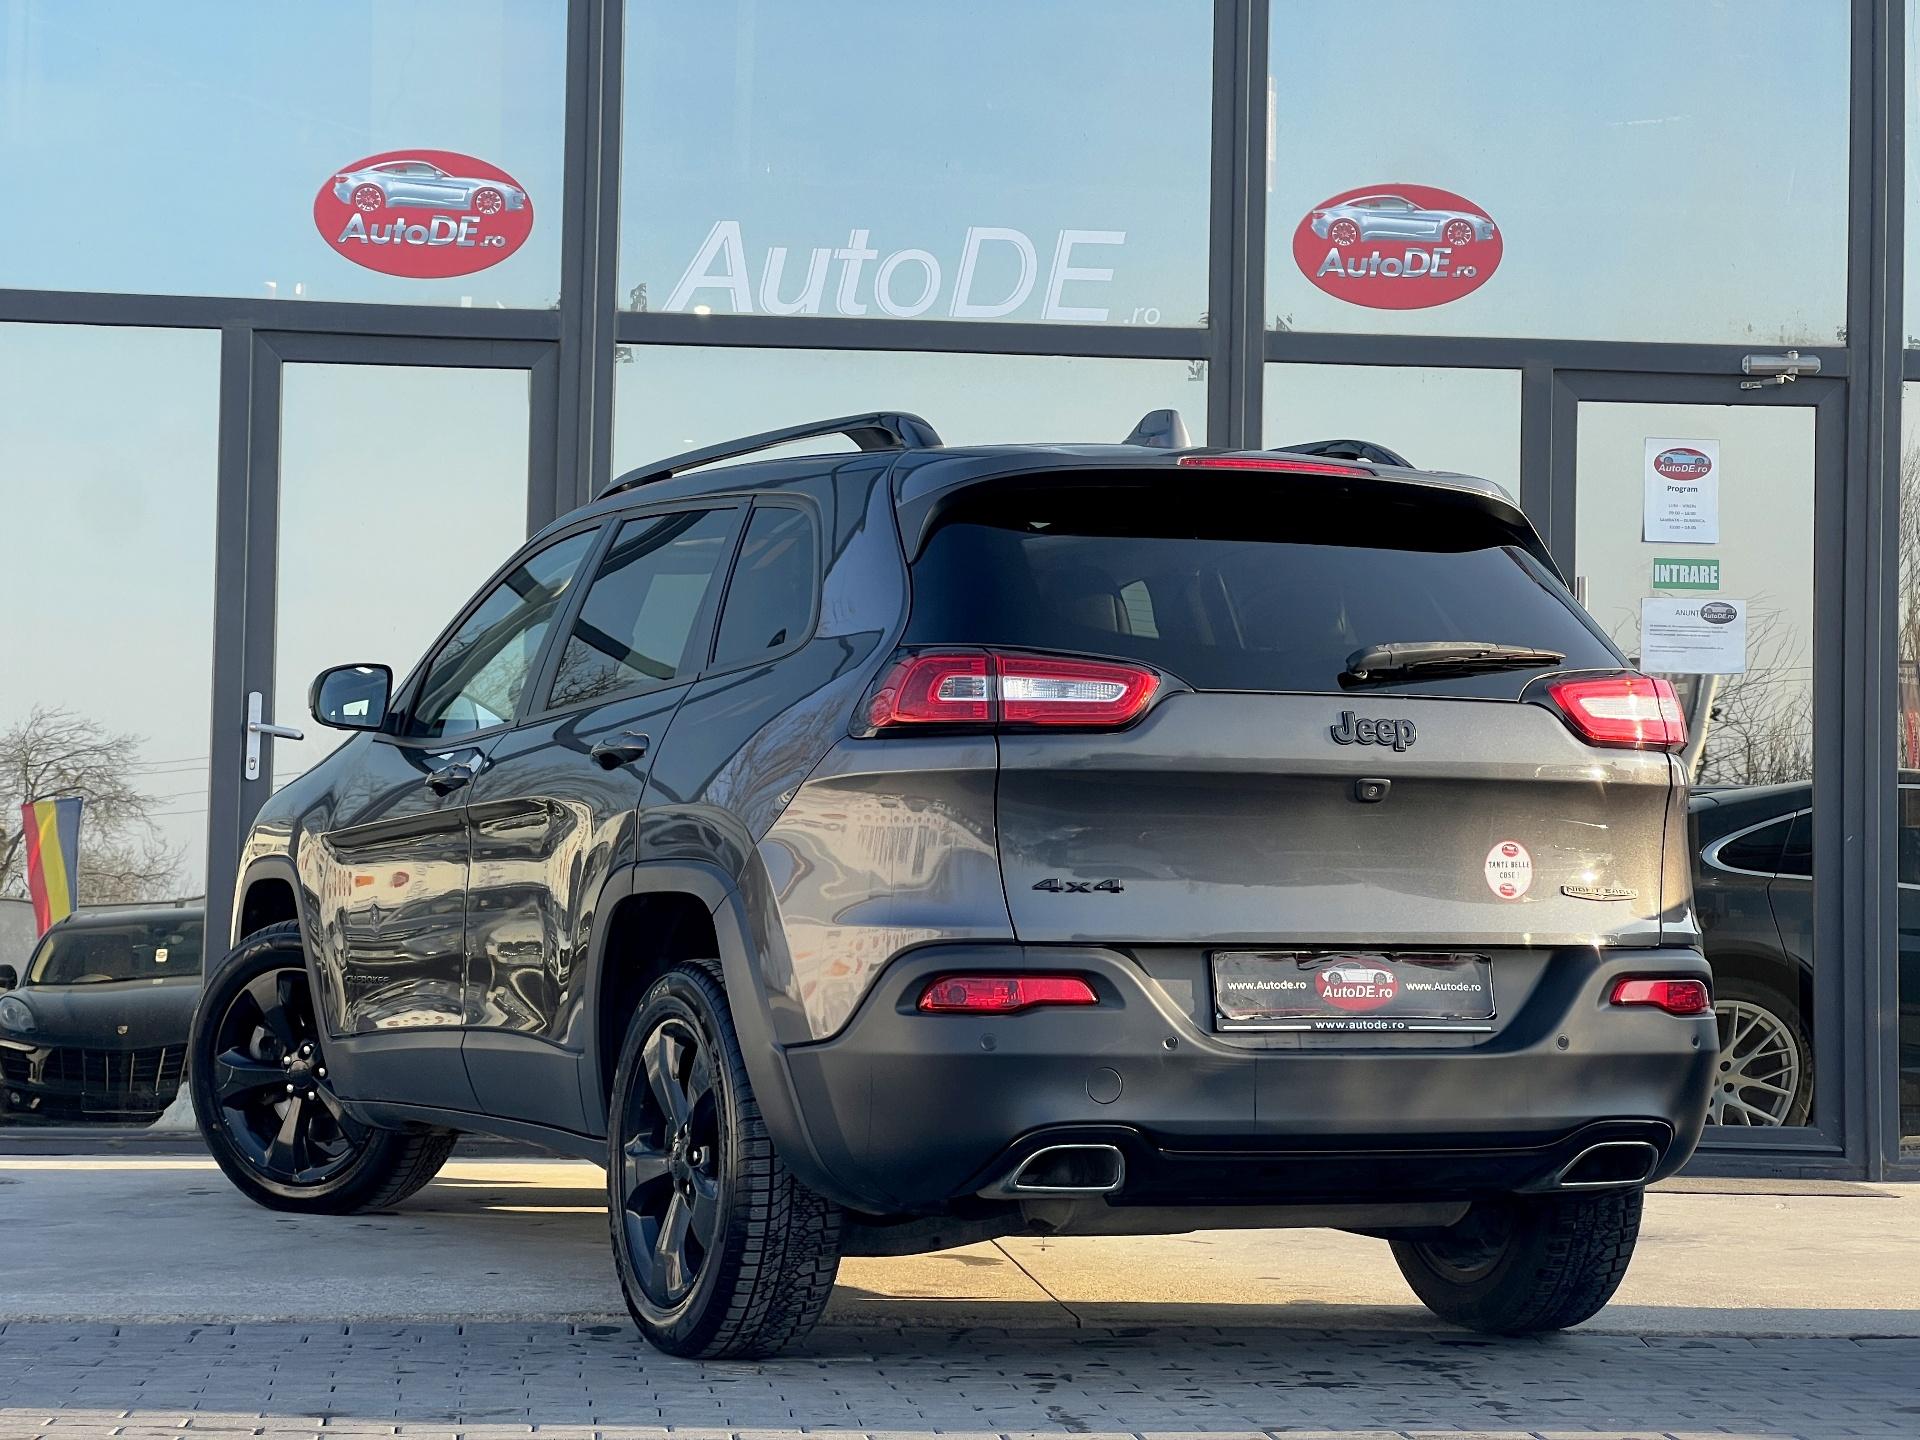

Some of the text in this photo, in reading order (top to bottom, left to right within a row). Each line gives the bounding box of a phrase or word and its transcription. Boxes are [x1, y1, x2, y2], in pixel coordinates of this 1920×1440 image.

[338, 213, 506, 247] AutoDE.ro
[1317, 247, 1477, 278] AutoDE.ro
[1658, 464, 1708, 473] AutoDE.ro
[1667, 485, 1698, 493] Program
[1654, 564, 1718, 584] INTRARE
[1330, 711, 1418, 752] Jeep
[1032, 878, 1125, 894] 4x4
[1227, 980, 1308, 990] www.Autode.ro
[1322, 985, 1394, 998] AutoDE.ro
[1405, 982, 1483, 992] www.Autode.ro
[1315, 1020, 1405, 1029] www.autode.ro
